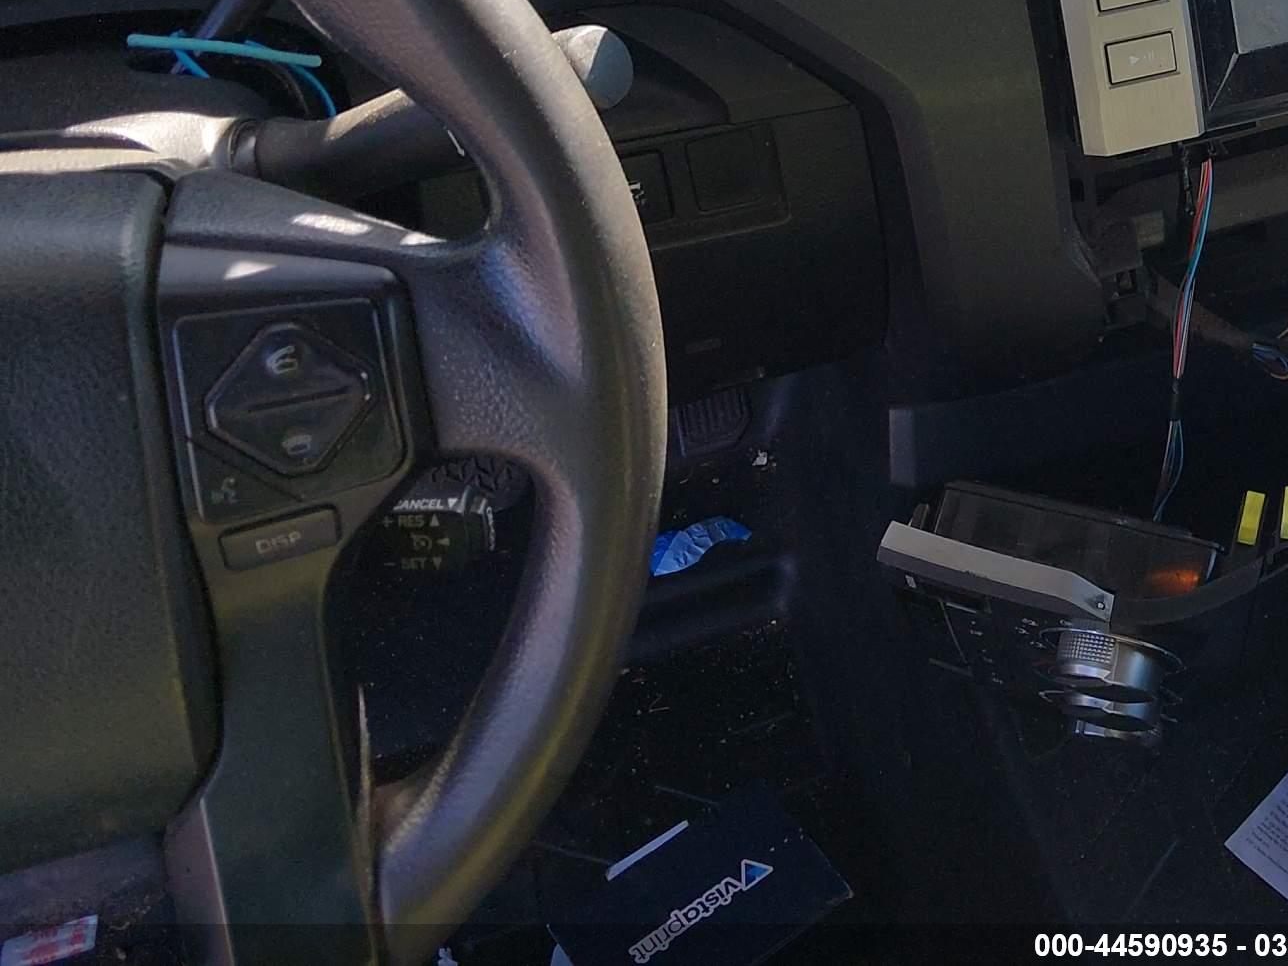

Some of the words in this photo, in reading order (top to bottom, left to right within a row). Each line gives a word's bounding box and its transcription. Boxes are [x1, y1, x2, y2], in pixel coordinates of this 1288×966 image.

[398, 514, 425, 528] RES
[401, 557, 426, 570] SET
[631, 878, 742, 962] vistaprint
